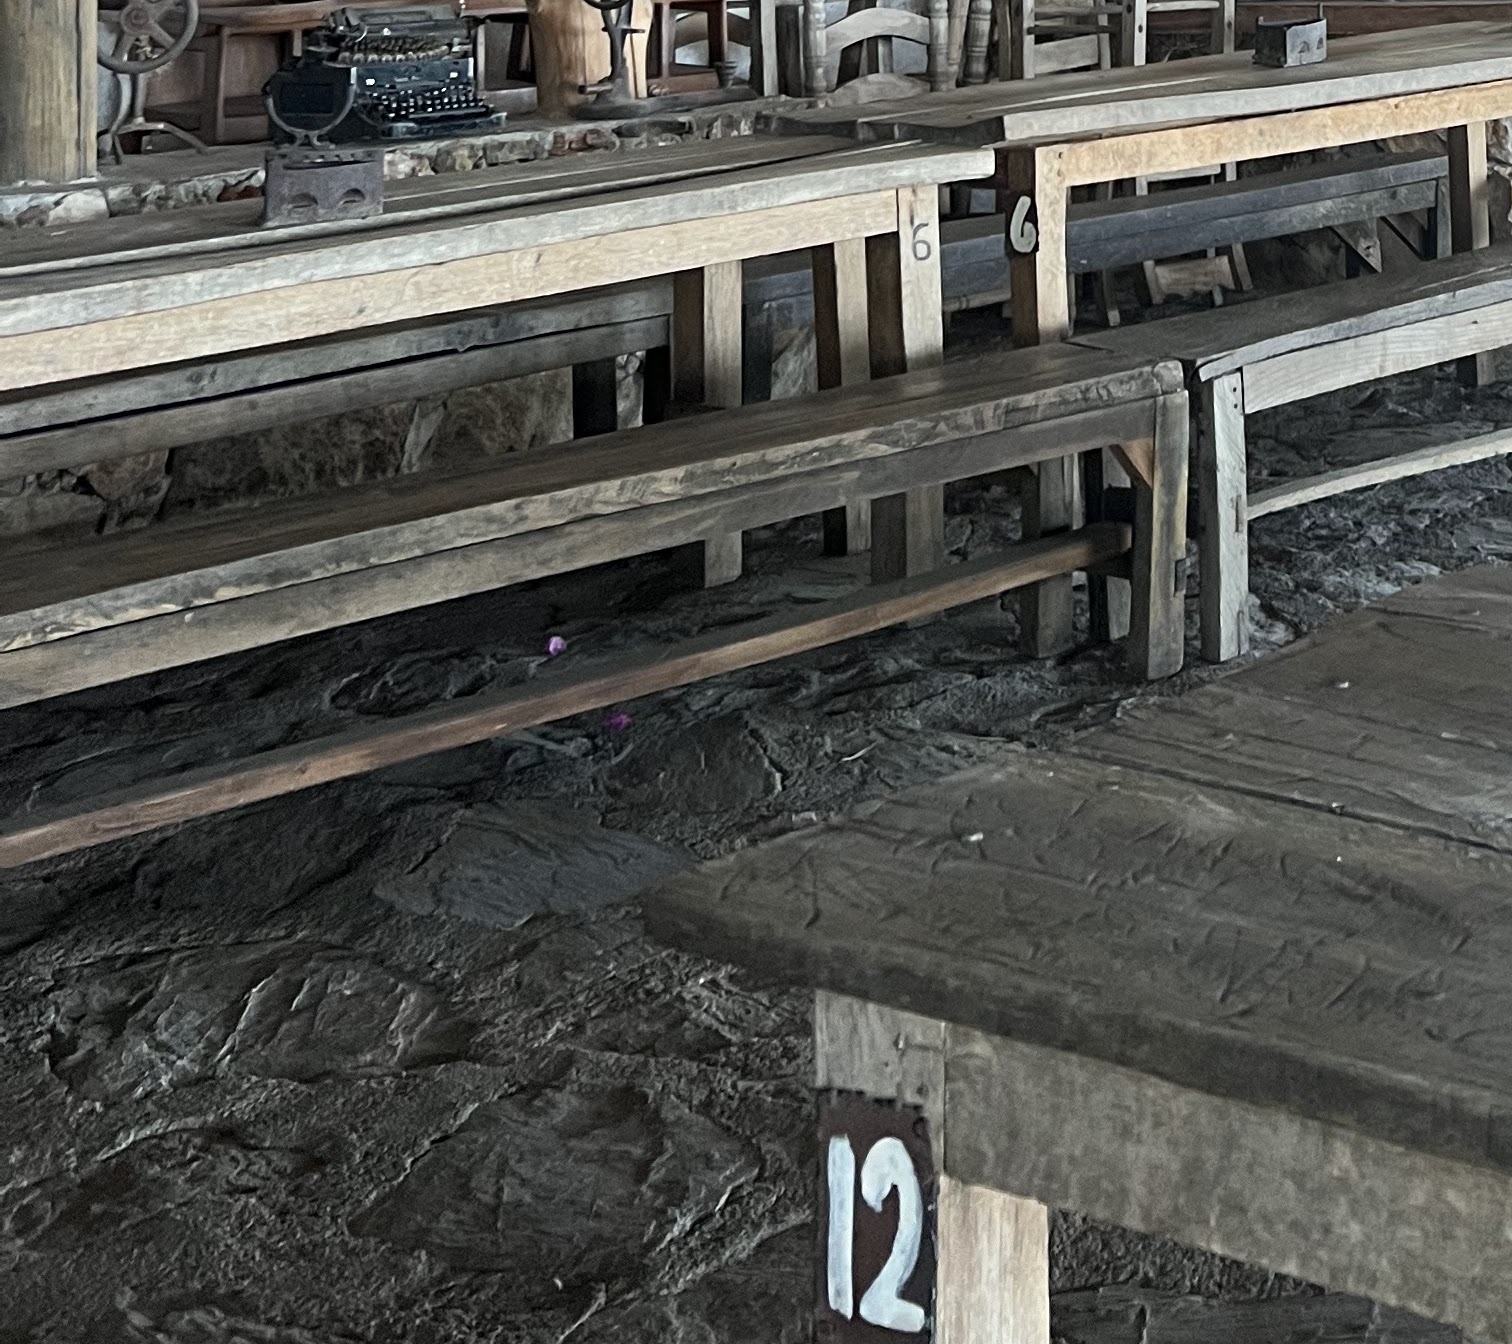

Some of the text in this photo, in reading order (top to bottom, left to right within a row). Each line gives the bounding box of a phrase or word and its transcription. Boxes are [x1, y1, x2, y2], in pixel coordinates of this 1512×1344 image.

[911, 221, 932, 261] 6
[1010, 195, 1037, 253] 6
[827, 1133, 925, 1333] 12
